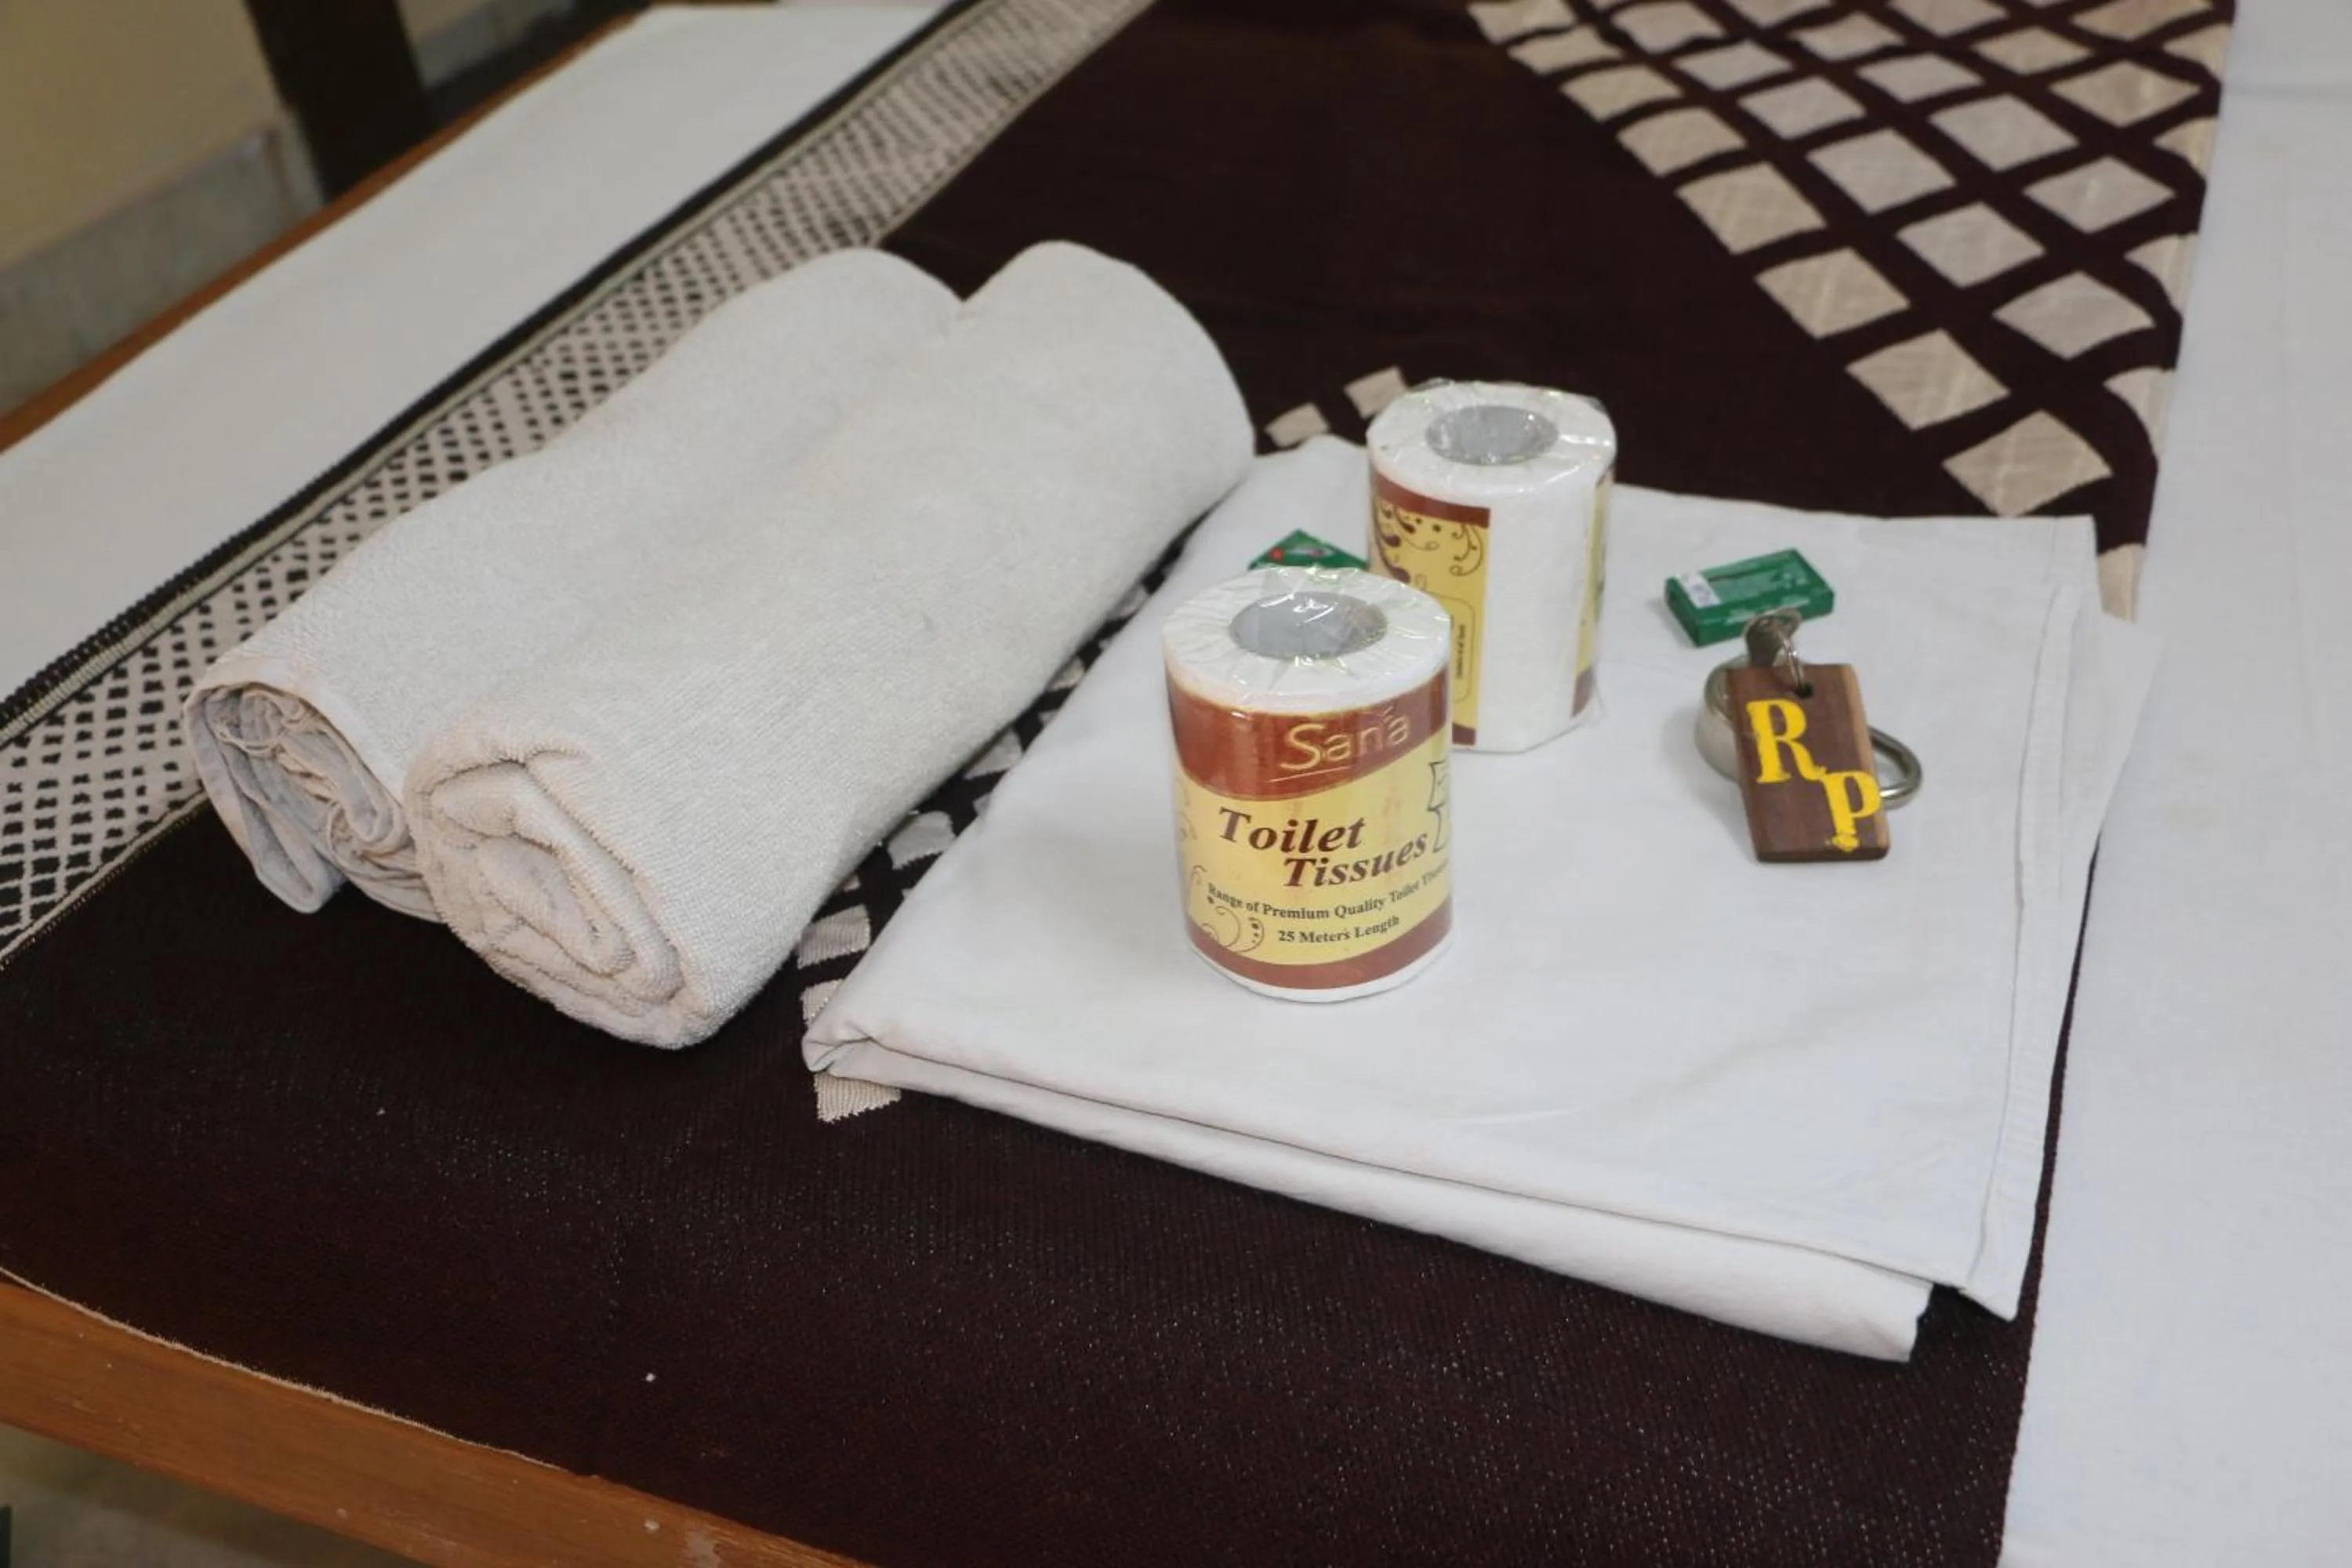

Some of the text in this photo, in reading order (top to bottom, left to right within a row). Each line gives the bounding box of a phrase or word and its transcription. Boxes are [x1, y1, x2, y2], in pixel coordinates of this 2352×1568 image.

[1279, 713, 1409, 770] Sana
[1219, 807, 1366, 854] Toilet
[1283, 833, 1428, 887] Tissues
[1207, 883, 1243, 909] Range
[1246, 902, 1261, 913] of
[1262, 902, 1330, 919] Premium
[1334, 898, 1385, 919] Quality
[1279, 916, 1400, 943] 25 Meters Length
